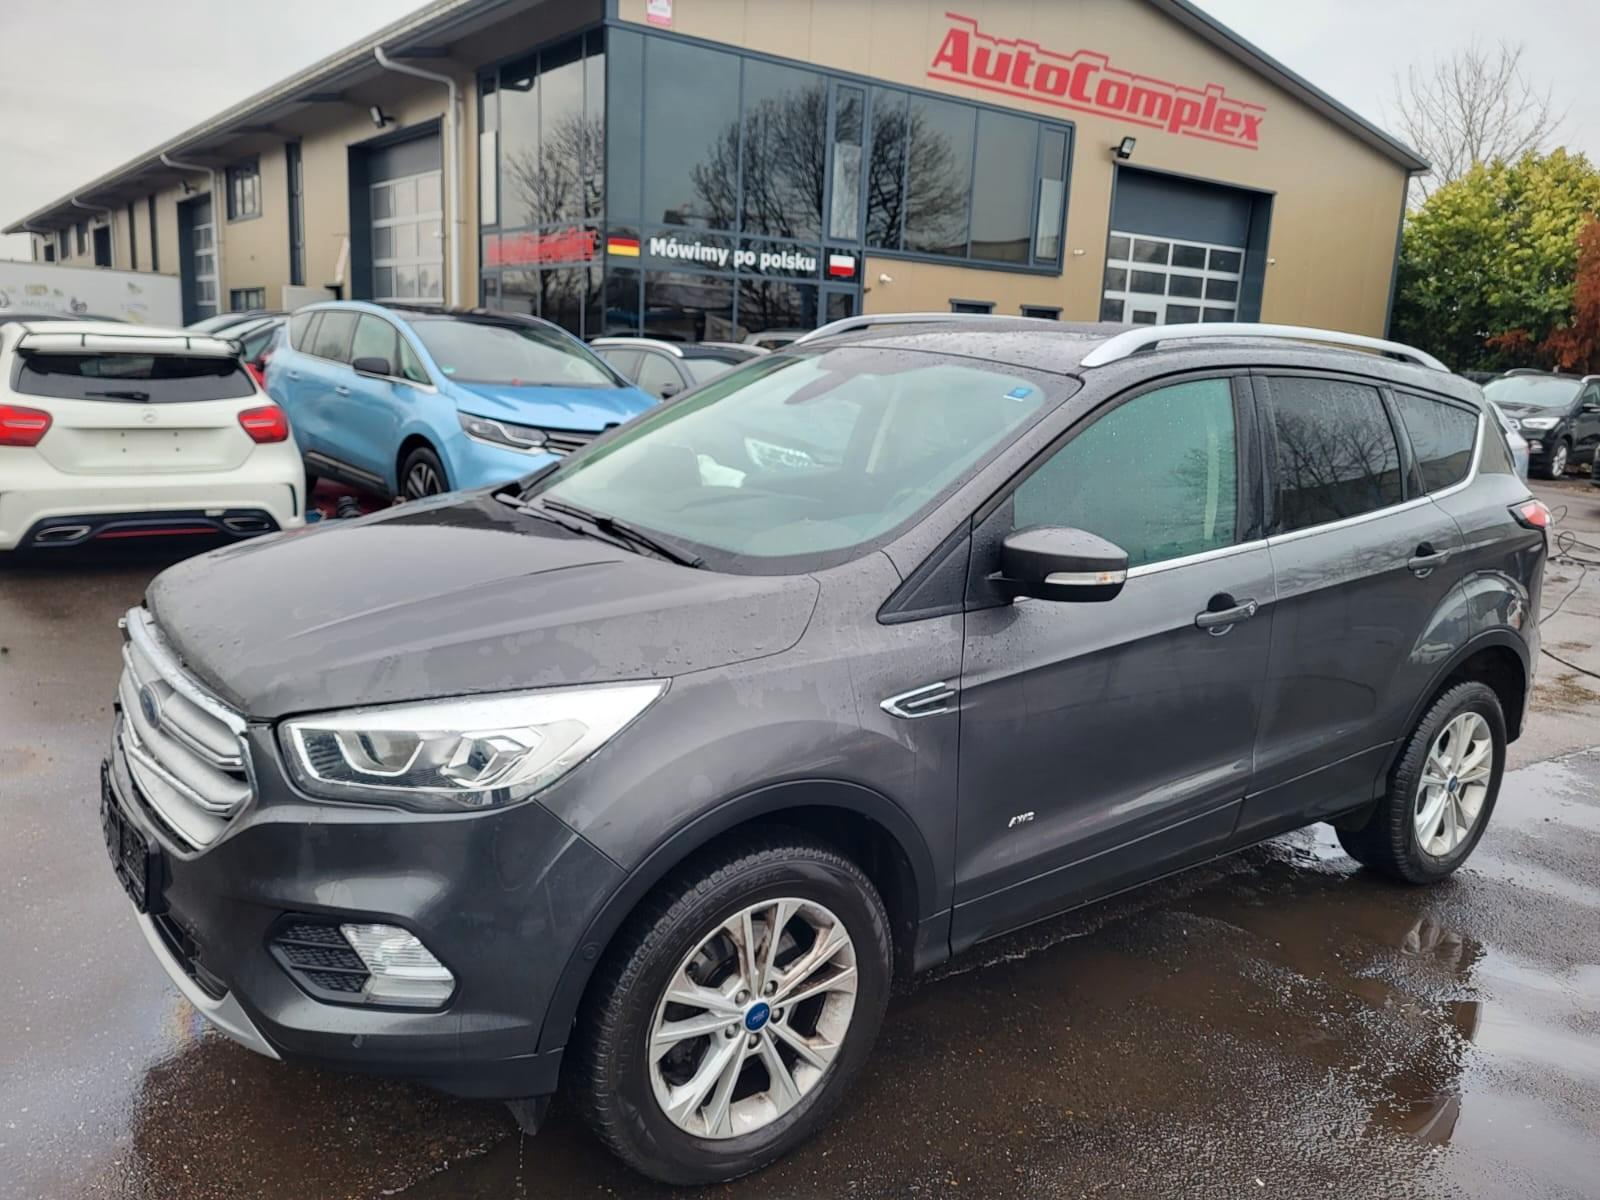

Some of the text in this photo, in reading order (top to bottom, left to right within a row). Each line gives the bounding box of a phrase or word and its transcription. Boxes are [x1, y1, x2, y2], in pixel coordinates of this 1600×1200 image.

[931, 26, 1264, 142] AutoComplex
[650, 237, 816, 271] Mówimy po polsku
